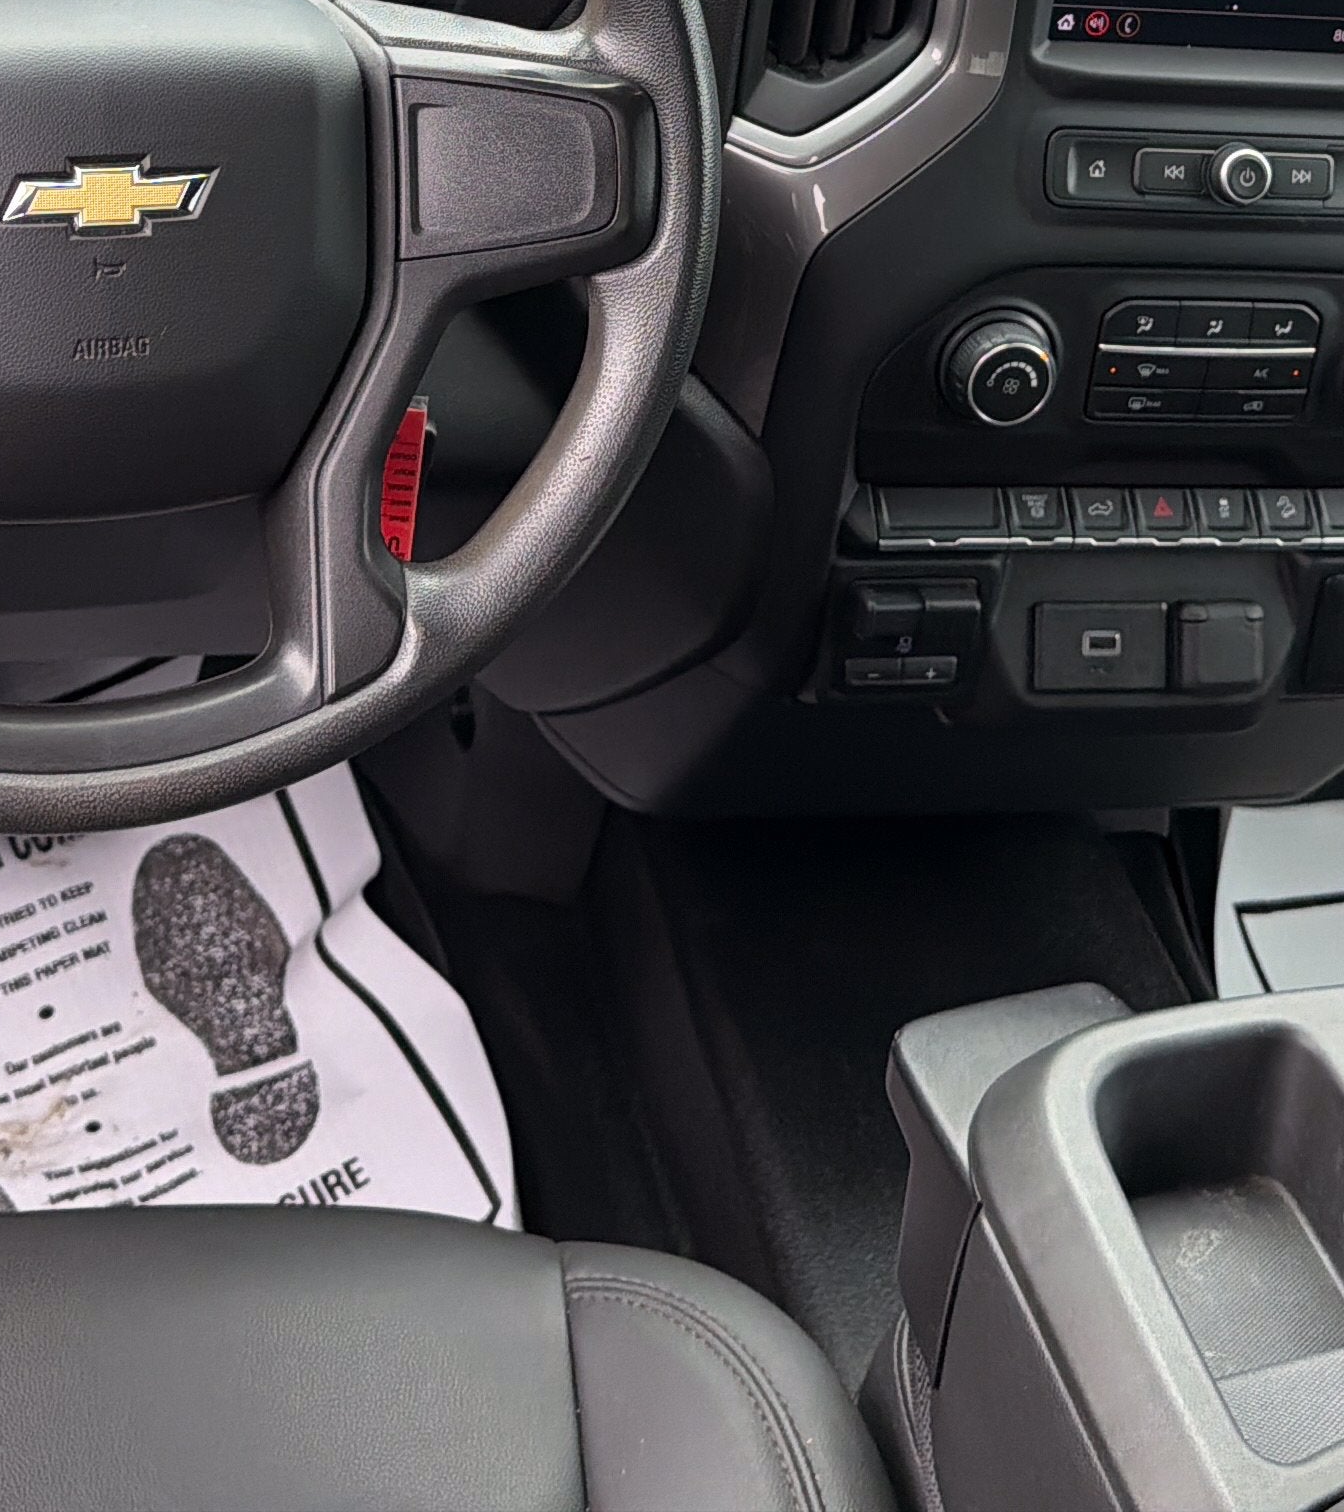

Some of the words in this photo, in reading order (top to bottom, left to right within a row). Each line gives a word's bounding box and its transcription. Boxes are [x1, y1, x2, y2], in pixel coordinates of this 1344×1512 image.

[73, 337, 150, 361] AIRBAG
[37, 893, 58, 910] TO
[60, 881, 94, 902] KEEP
[63, 910, 109, 935] CLEAN
[0, 972, 33, 996] THIS
[34, 952, 81, 981] PAPER
[82, 939, 111, 961] MAT
